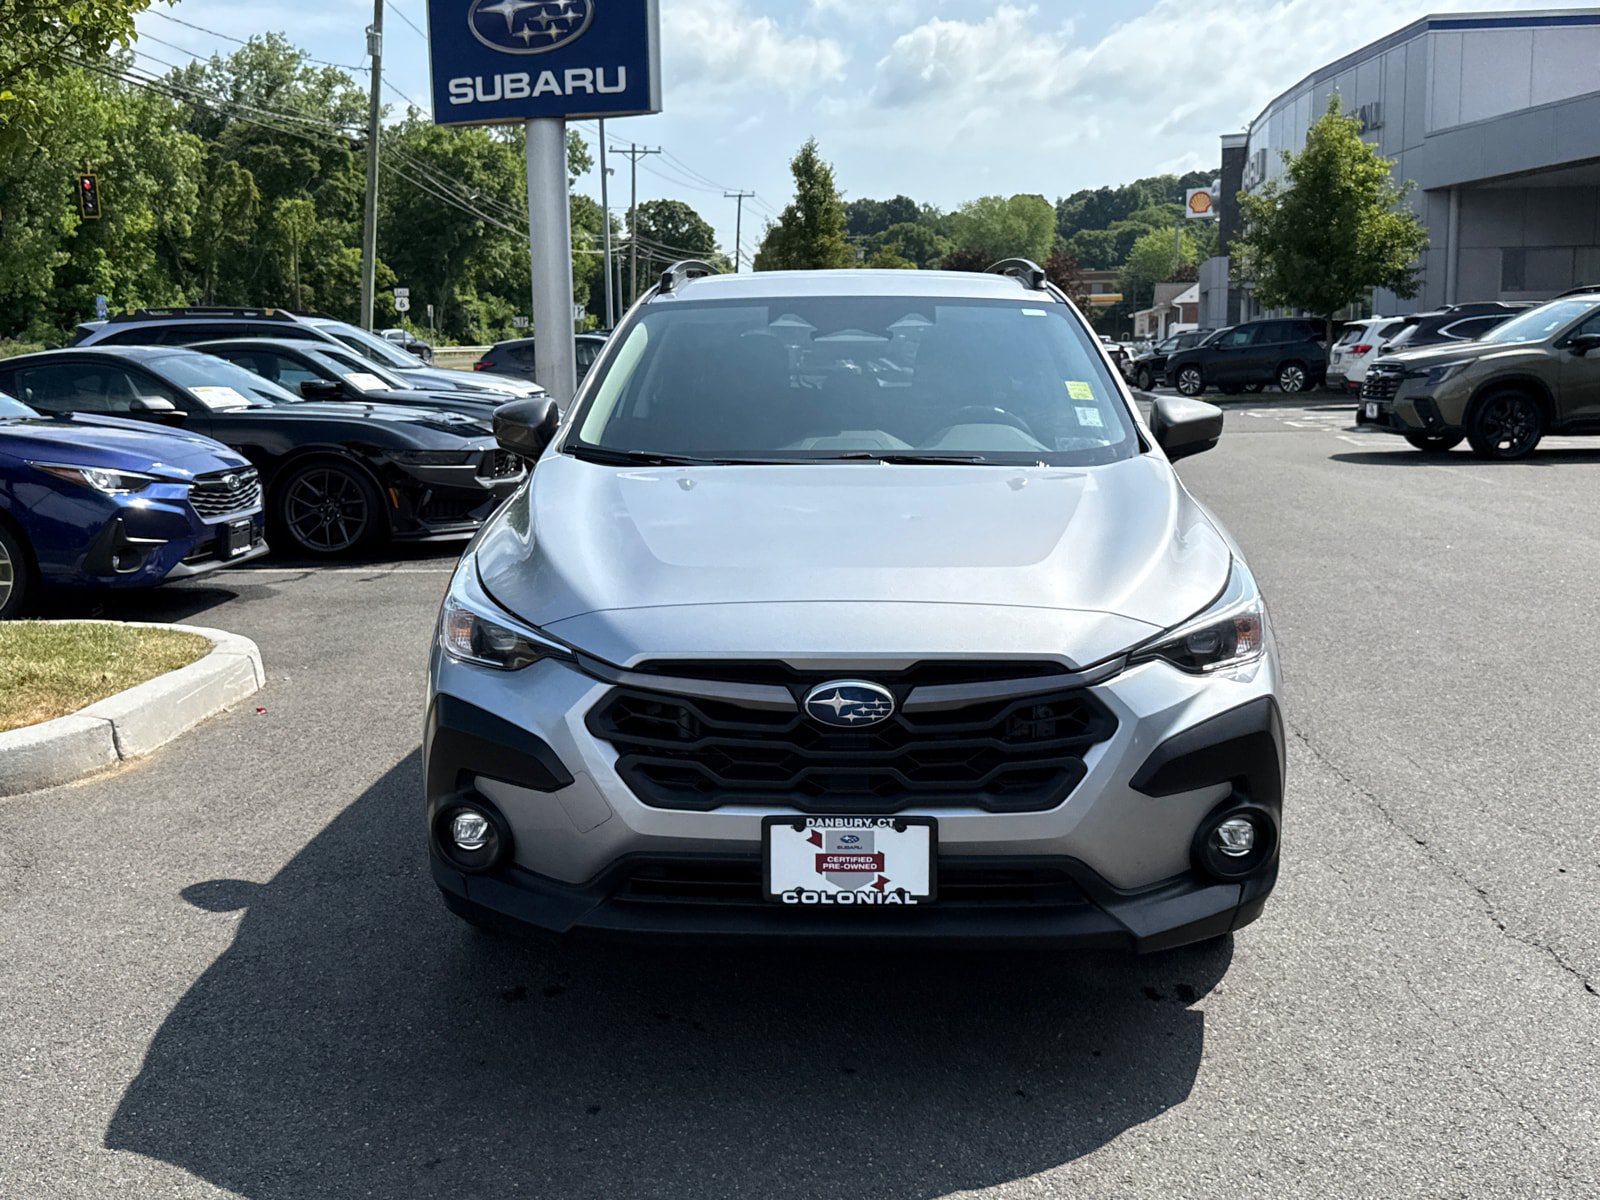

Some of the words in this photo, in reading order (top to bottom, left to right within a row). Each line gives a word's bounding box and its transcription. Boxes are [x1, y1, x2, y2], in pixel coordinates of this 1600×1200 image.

[448, 66, 627, 105] SUBARU
[399, 299, 406, 309] 6
[805, 818, 873, 829] DANBURY,
[877, 818, 896, 828] CT
[782, 891, 918, 905] COLONIAL
